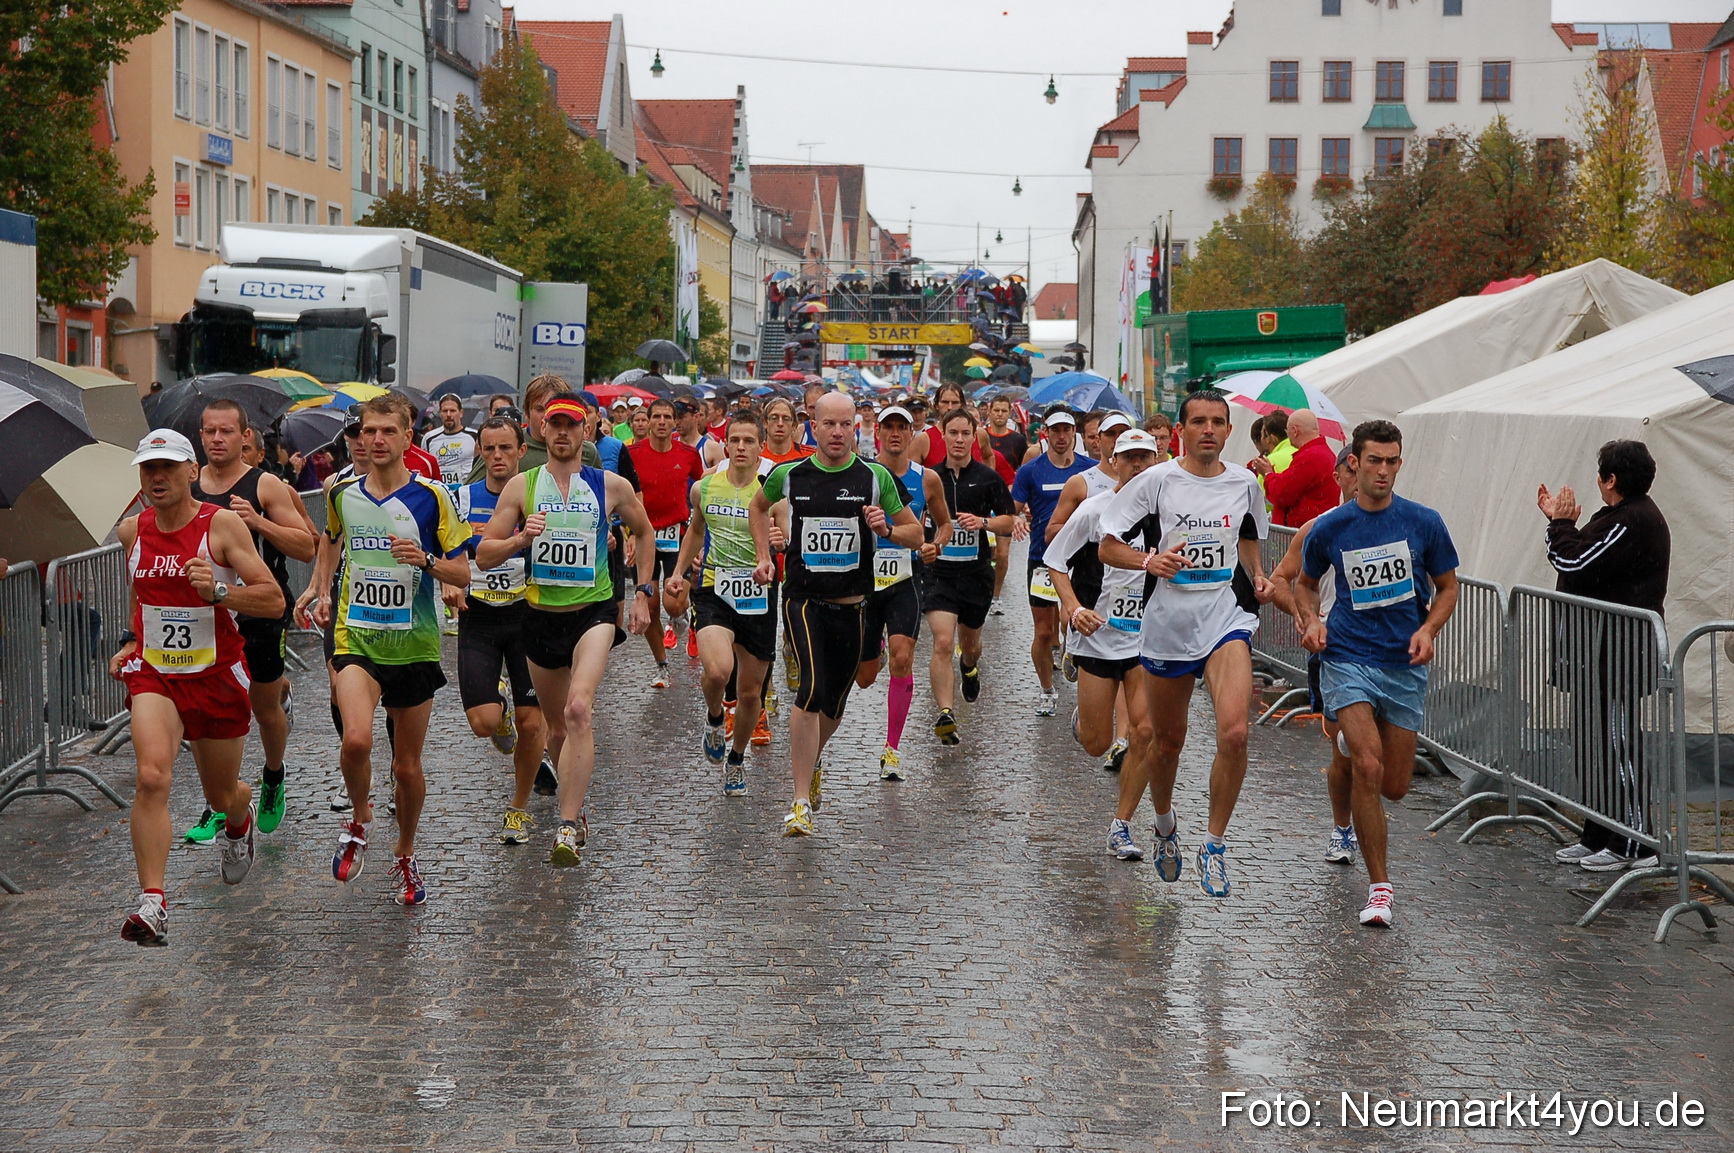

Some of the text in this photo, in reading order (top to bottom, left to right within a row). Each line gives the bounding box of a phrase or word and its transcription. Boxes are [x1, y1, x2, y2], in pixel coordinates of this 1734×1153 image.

[240, 281, 325, 300] BOCK
[868, 327, 921, 340] START
[538, 502, 592, 512] BOCK
[710, 496, 742, 505] TEAM
[1175, 513, 1231, 530] Xplus1
[350, 525, 387, 535] TEAM
[807, 532, 856, 552] 3077
[538, 542, 588, 566] 2001
[818, 556, 846, 564] Jochen
[153, 554, 182, 574] DJK
[879, 560, 898, 576] 40
[364, 570, 392, 578] BOCK
[549, 569, 576, 578] Marco
[1190, 573, 1210, 581] Rudi
[1351, 558, 1407, 588] 3248
[486, 573, 511, 590] 36
[354, 581, 406, 607] 2000
[720, 580, 763, 598] 2083
[1371, 587, 1395, 600] Avdyl
[160, 611, 191, 619] BOCK
[362, 609, 394, 621] Michael
[162, 624, 192, 649] 23
[162, 653, 194, 665] Martin
